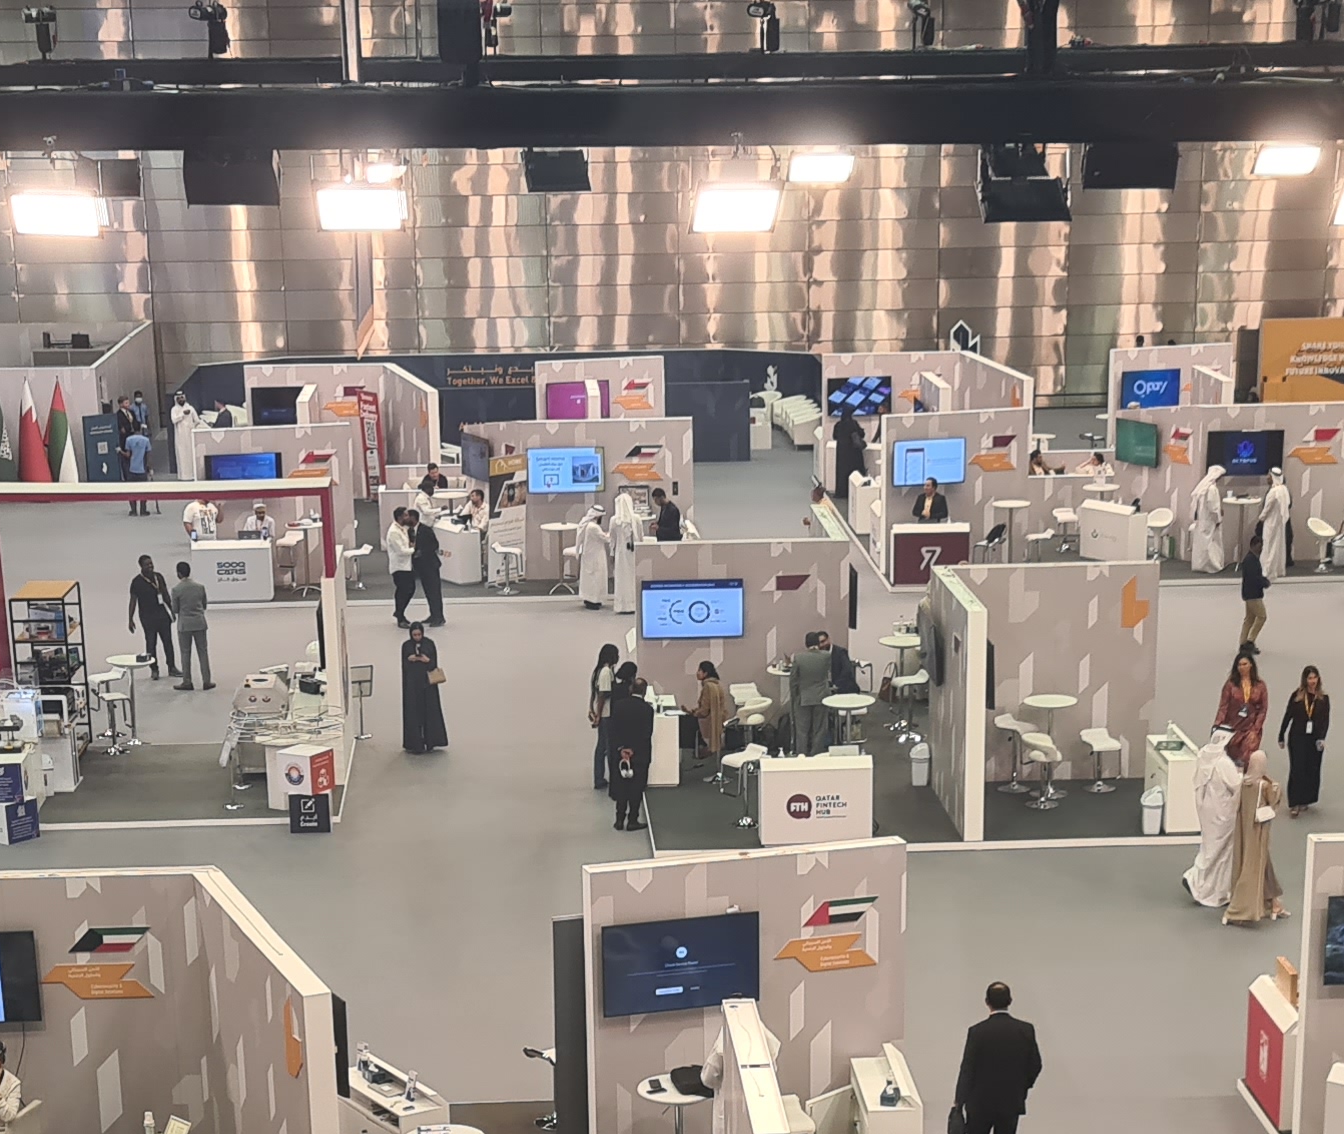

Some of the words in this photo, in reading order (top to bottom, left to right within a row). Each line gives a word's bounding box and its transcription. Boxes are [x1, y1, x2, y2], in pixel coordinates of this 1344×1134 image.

[1301, 342, 1326, 350] SHARE
[1290, 354, 1337, 363] KNOWLEDGE
[1285, 367, 1314, 376] FUTURE
[447, 377, 488, 387] Together,
[490, 377, 503, 385] We
[506, 376, 529, 384] Excel
[790, 802, 809, 812] FTH
